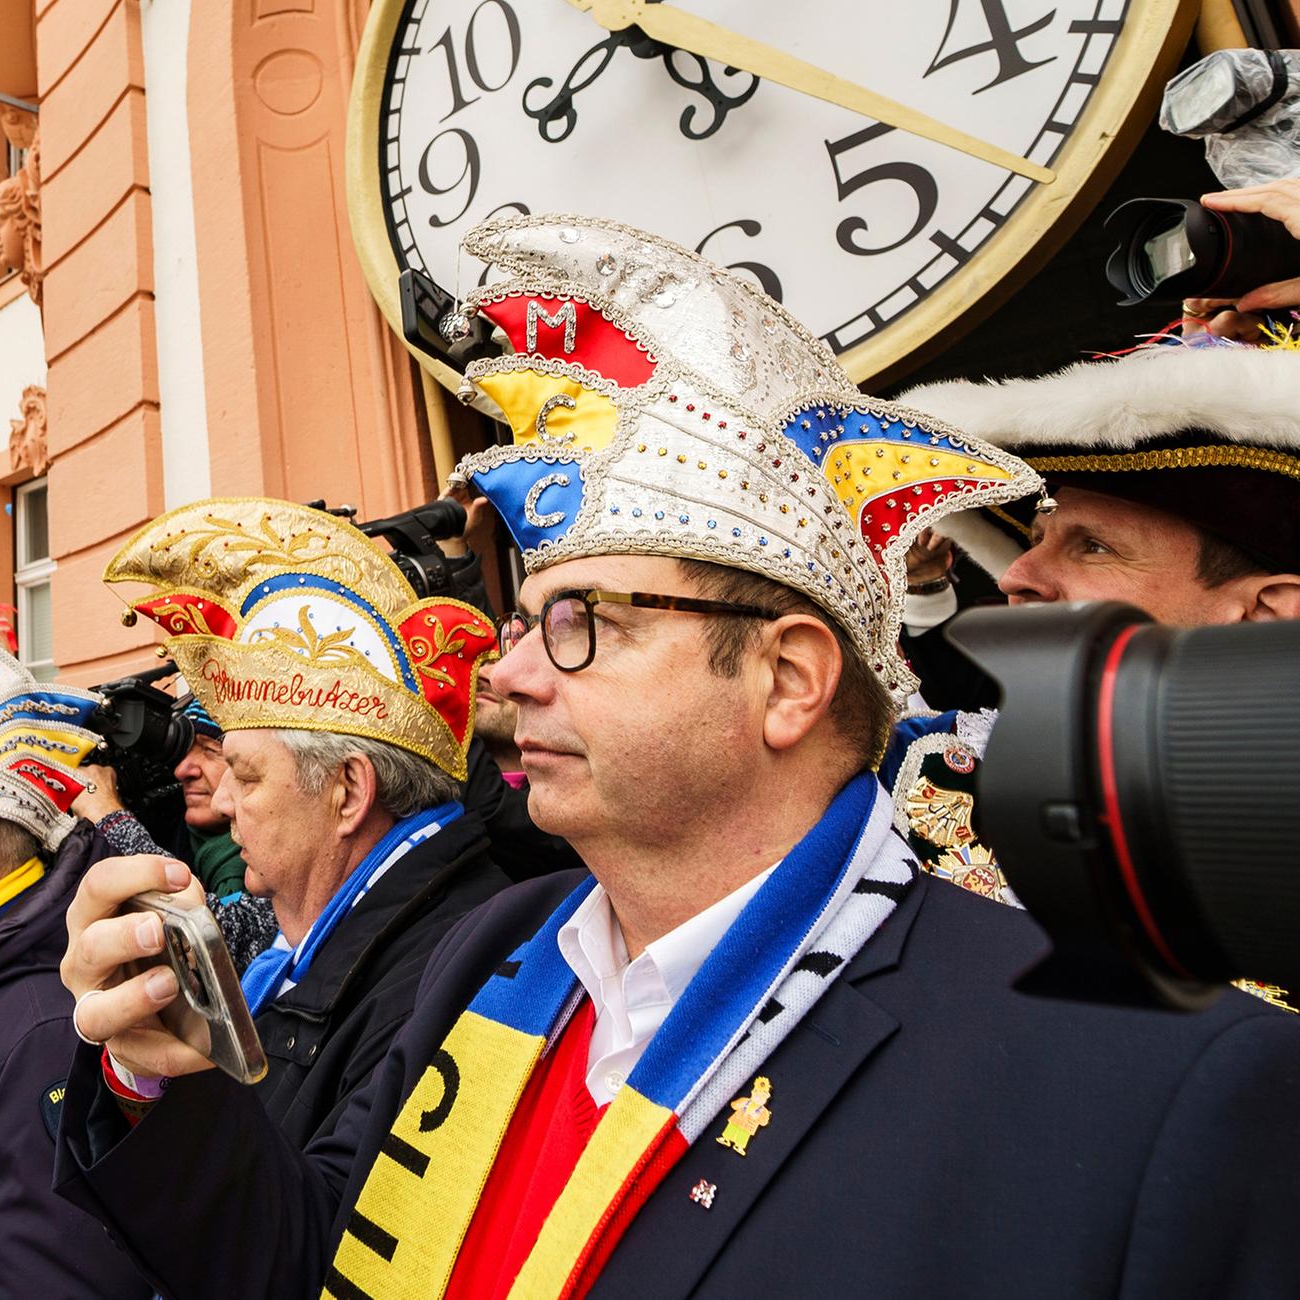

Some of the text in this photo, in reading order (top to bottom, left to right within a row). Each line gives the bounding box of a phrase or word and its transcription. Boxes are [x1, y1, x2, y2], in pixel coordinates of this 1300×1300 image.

[427, 0, 521, 124] 10
[922, 0, 1058, 95] 4
[418, 128, 480, 228] 9
[824, 121, 939, 256] 5
[525, 300, 577, 527] M C C
